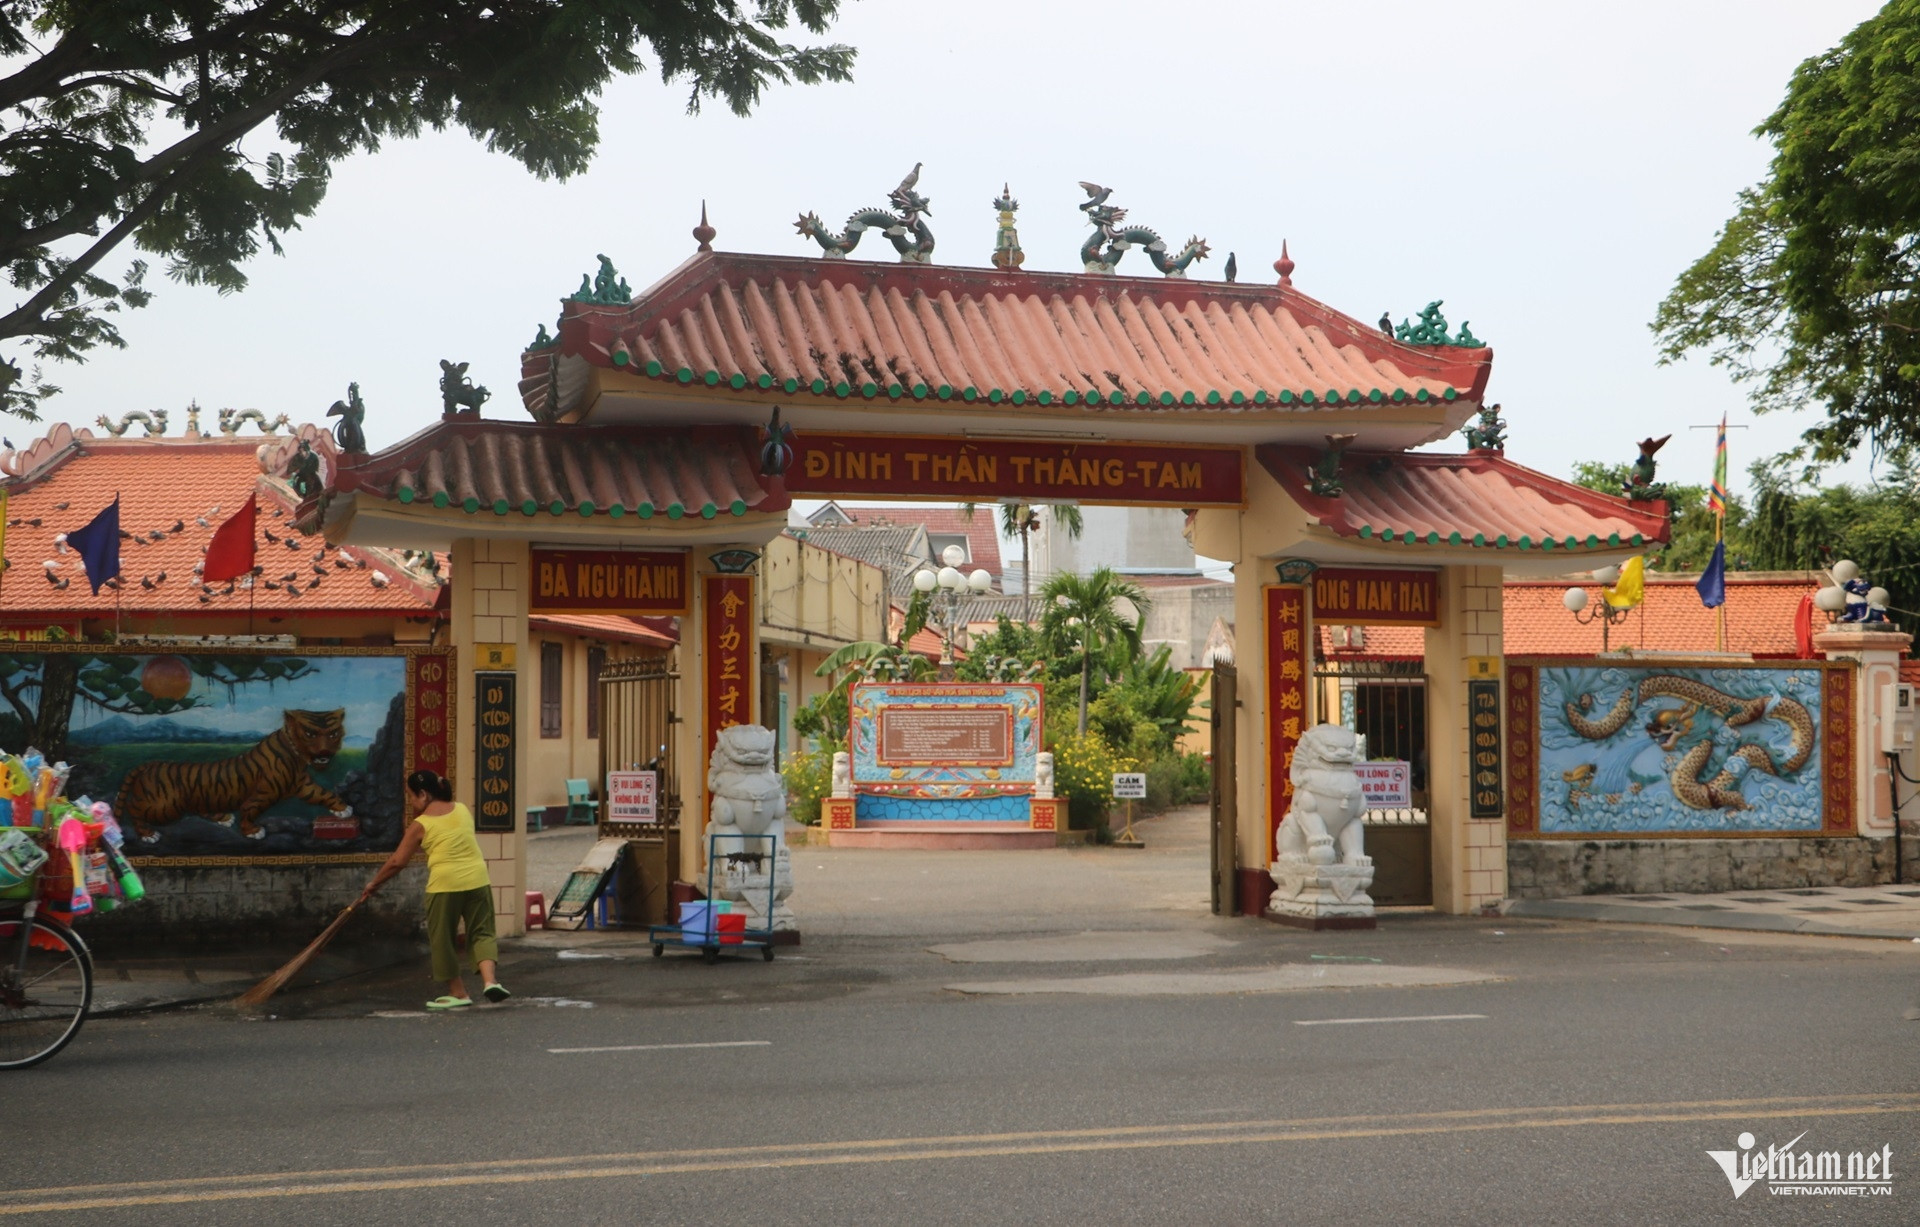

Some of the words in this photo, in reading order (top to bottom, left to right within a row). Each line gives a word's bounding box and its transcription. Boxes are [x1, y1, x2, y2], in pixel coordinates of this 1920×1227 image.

[805, 442, 892, 480] ĐÌNH
[905, 444, 997, 483] THẦN
[482, 708, 511, 726] TÍCH
[482, 732, 511, 751] LỊCH
[1389, 783, 1400, 792] XE
[642, 795, 649, 804] XE
